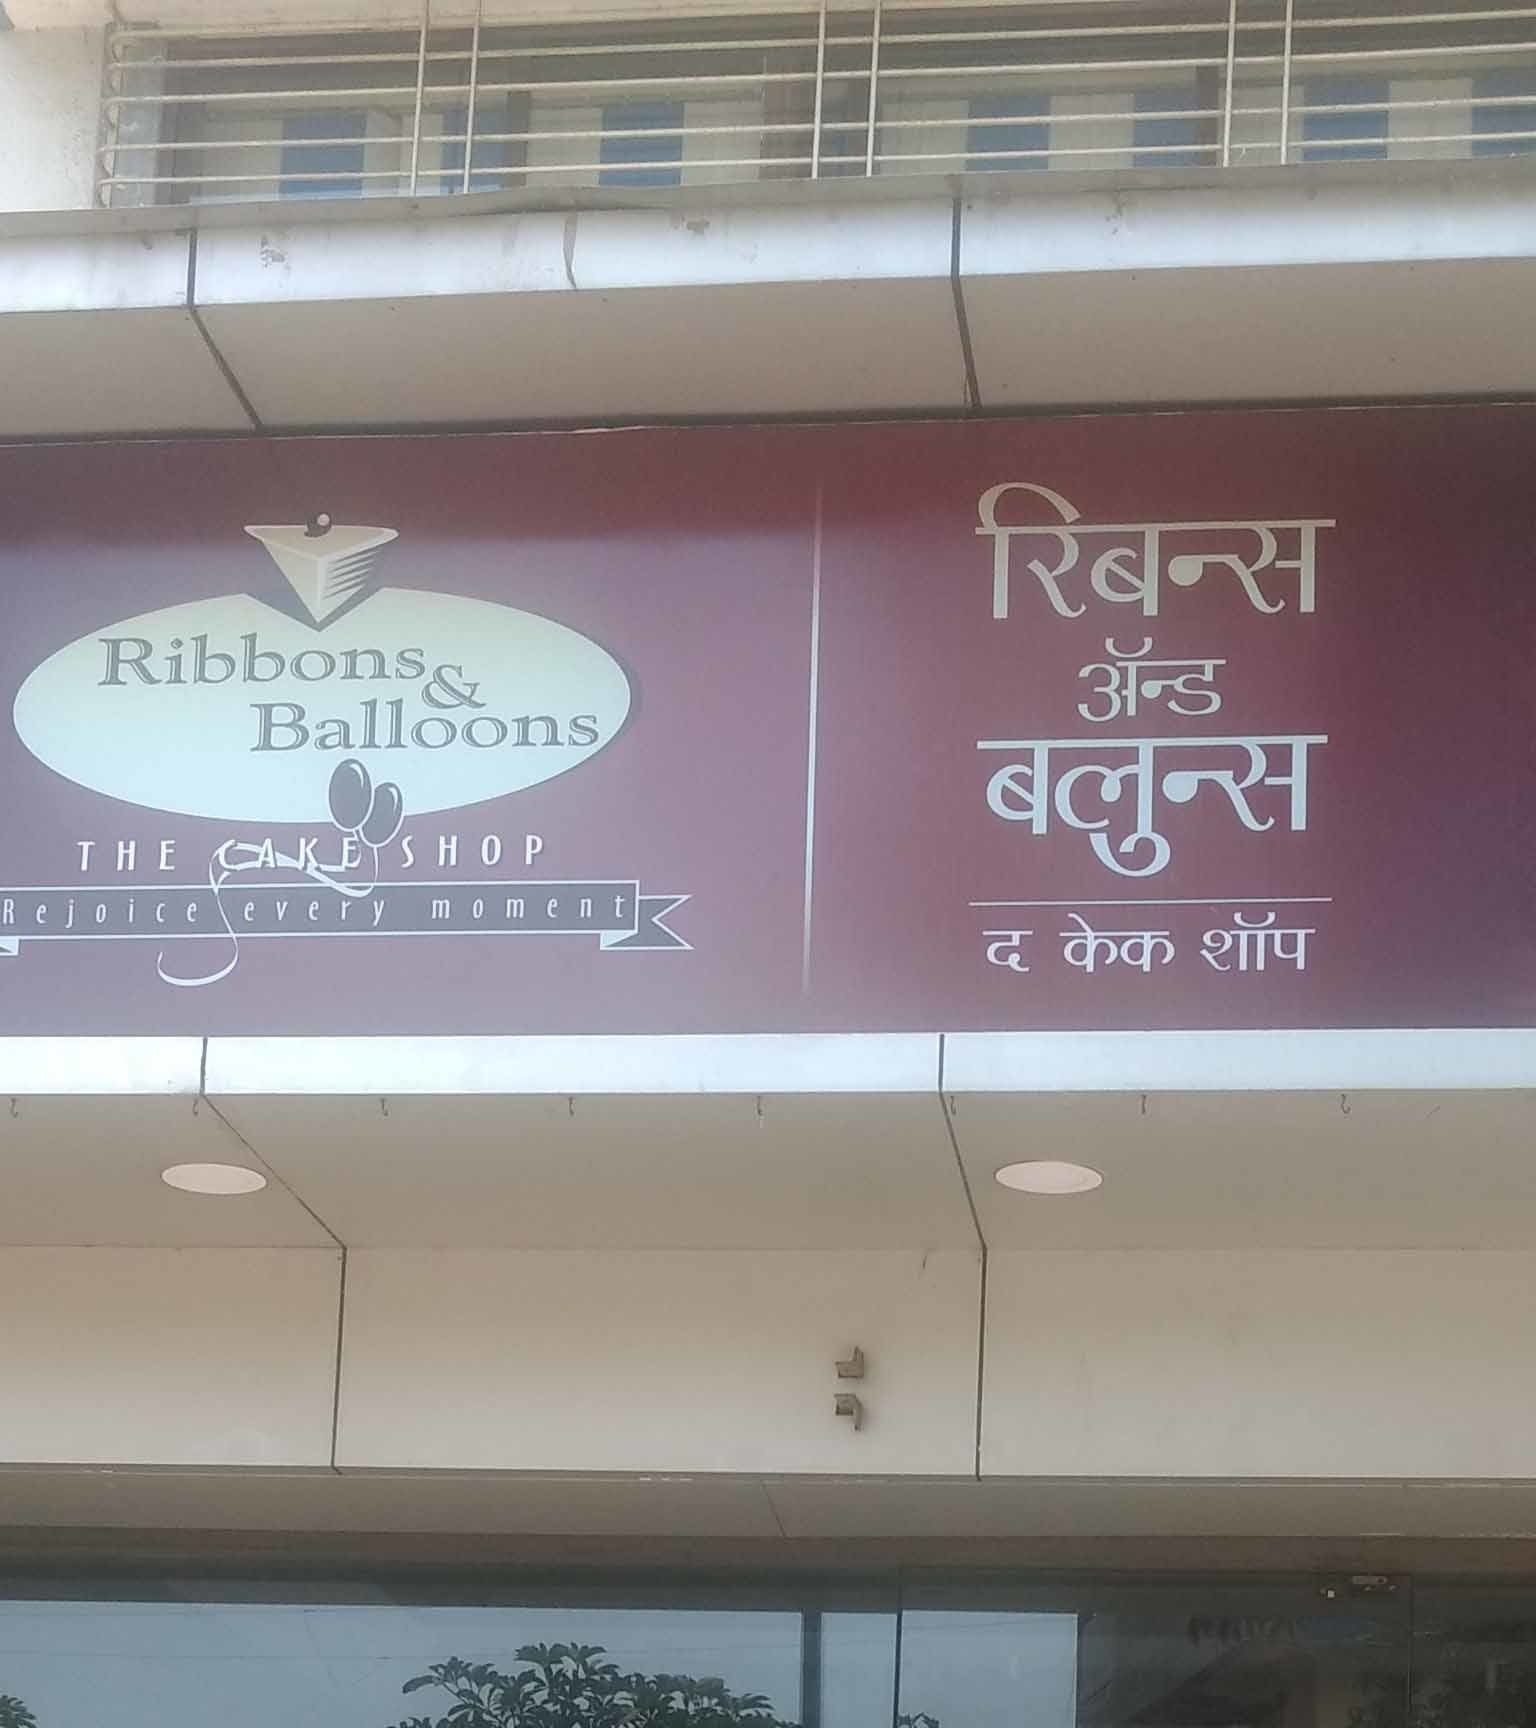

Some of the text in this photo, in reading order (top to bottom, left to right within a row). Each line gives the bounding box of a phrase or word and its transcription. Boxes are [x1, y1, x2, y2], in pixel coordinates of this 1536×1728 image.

[975, 482, 1337, 619] रिबन्स
[98, 632, 486, 709] Ribbons &
[250, 698, 600, 752] Balloons
[977, 735, 1329, 877] बलुन्स
[76, 834, 545, 873] THE CAKE SHOP
[1, 894, 626, 929] Rejoice every moment
[982, 911, 1316, 972] द केक शॉप
